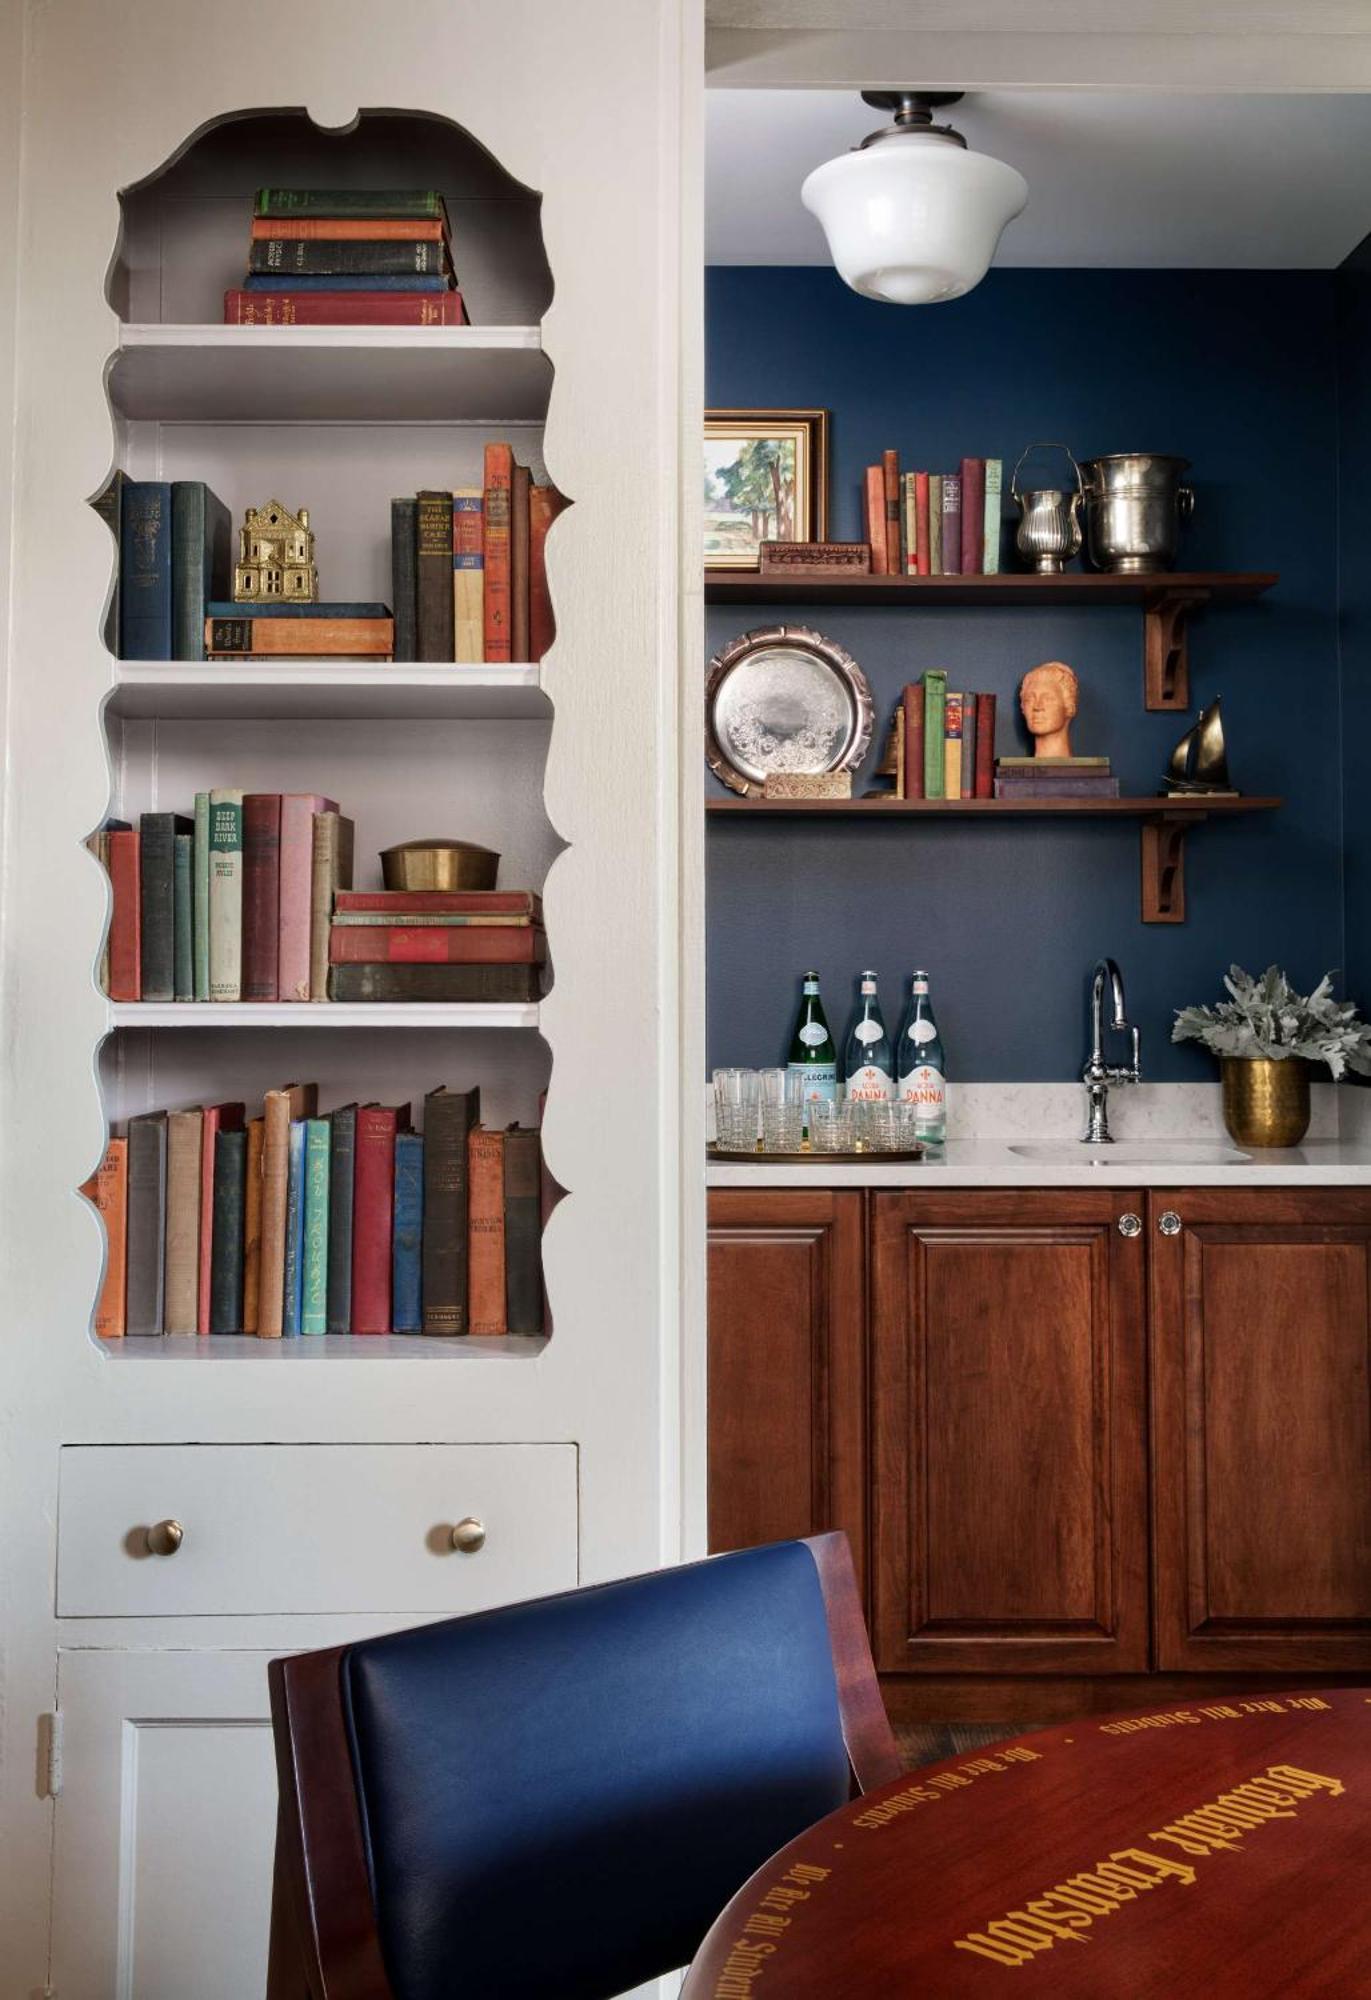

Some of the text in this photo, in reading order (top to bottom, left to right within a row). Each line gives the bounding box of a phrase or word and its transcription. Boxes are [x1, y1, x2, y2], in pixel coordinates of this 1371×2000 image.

[215, 822, 236, 832] DARK
[216, 811, 235, 821] DEEP
[213, 832, 238, 843] RIVER
[1099, 1697, 1331, 1735] We Are All Students
[853, 1747, 1043, 1829] We Are All Students
[954, 1764, 1345, 1966] Graduate Evanston
[713, 1863, 832, 2000] We Are All Student
